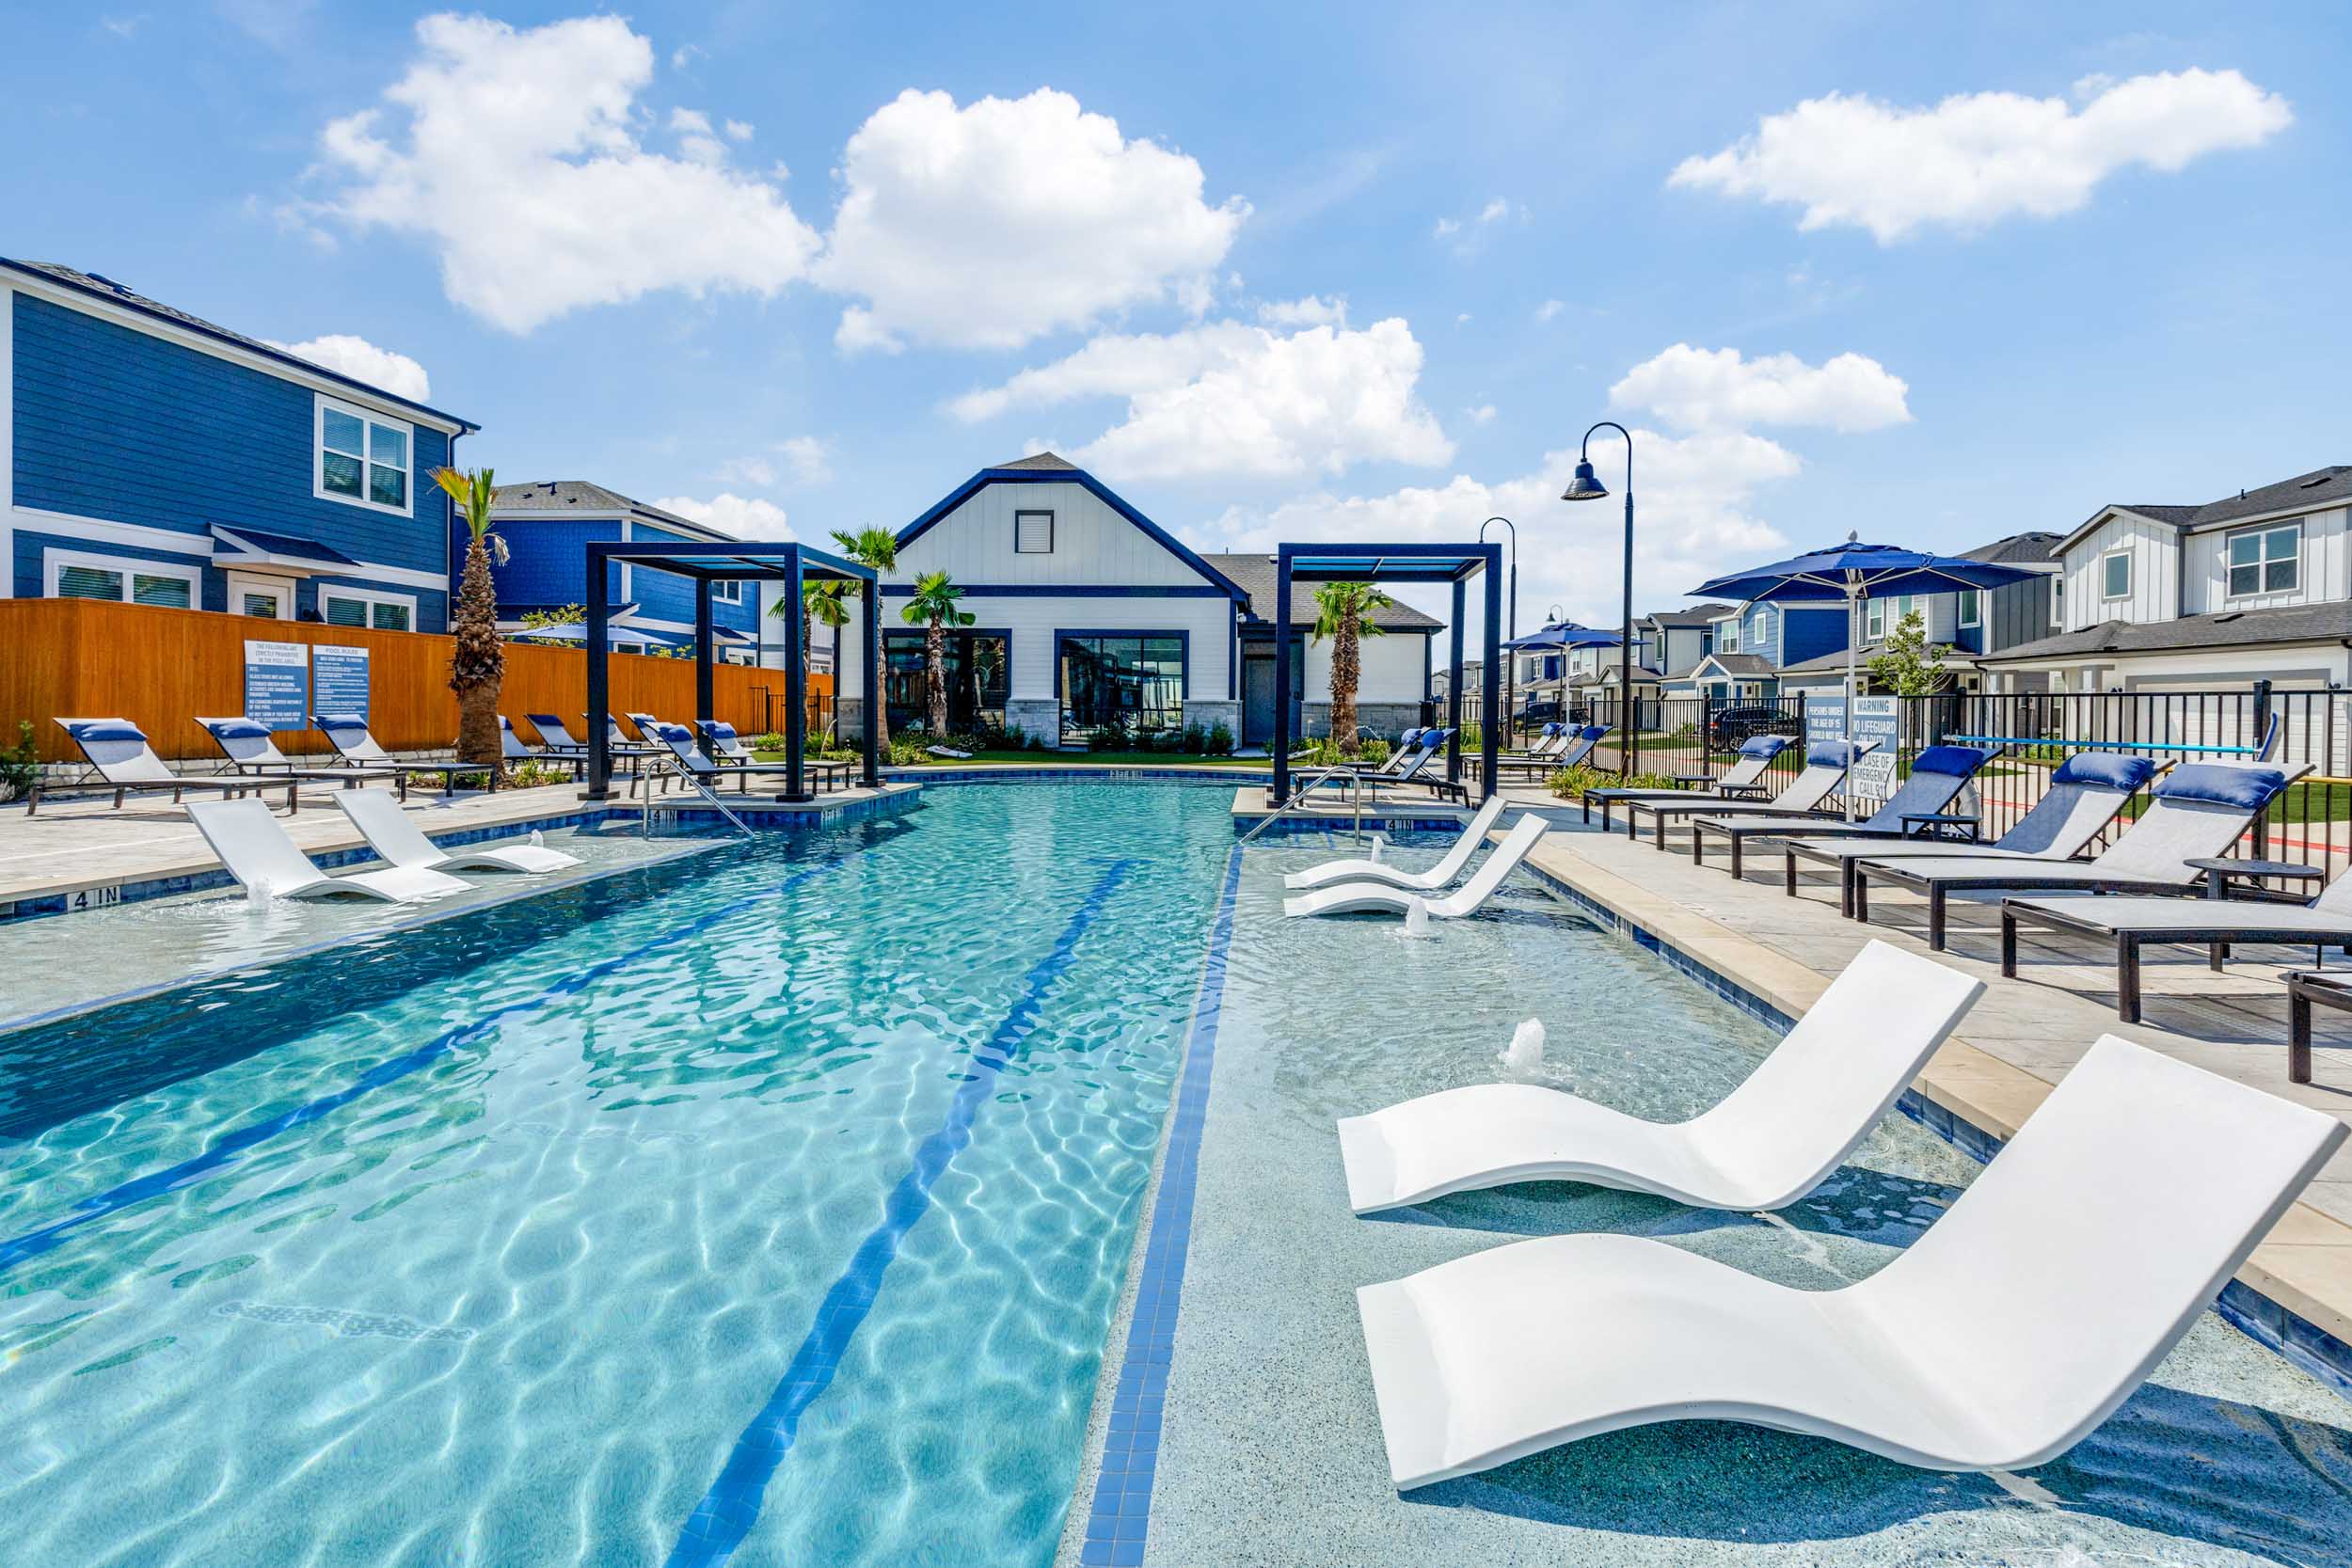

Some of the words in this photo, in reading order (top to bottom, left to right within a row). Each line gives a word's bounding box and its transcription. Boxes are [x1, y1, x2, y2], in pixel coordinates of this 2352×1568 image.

[1857, 699, 1890, 713] WARNING
[1861, 720, 1897, 735] LIFEGUARD
[1864, 754, 1880, 768] CASE
[1881, 756, 1890, 768] OF
[1859, 782, 1874, 796] CALL
[653, 810, 660, 820] 4
[665, 810, 675, 821] IN
[74, 892, 88, 908] 4
[99, 887, 117, 904] IN
